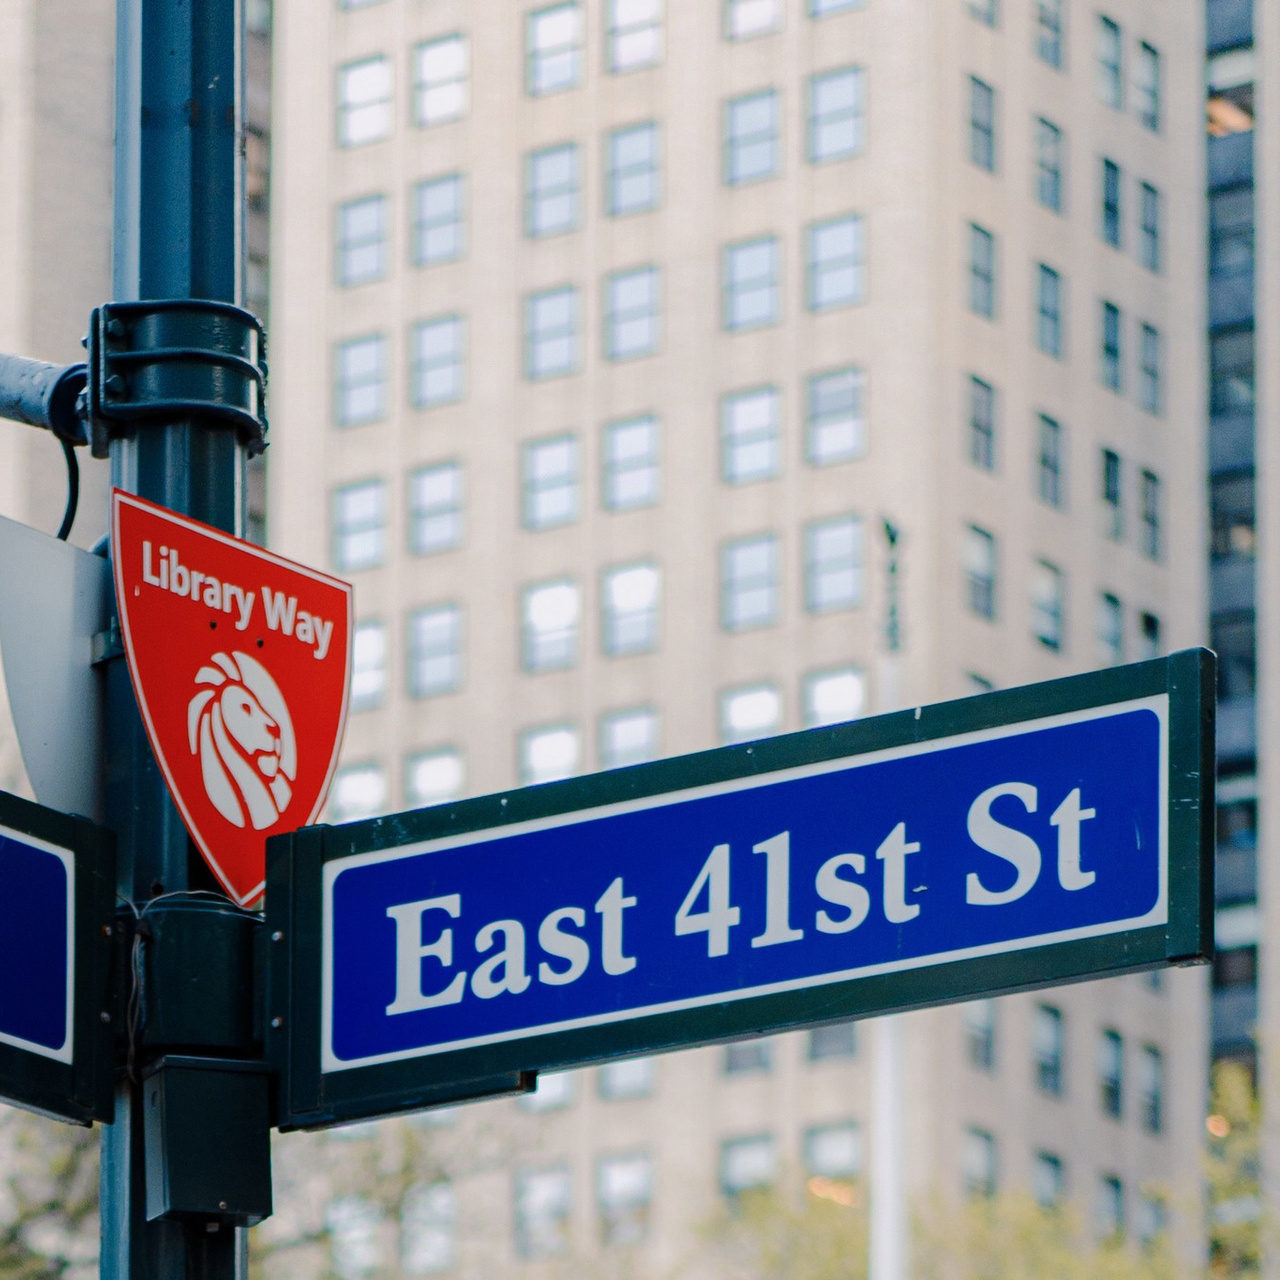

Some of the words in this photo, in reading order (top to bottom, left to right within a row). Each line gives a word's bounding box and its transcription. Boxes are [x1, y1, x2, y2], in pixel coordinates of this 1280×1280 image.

[142, 540, 256, 631] Library
[261, 586, 334, 660] Way
[386, 877, 637, 1016] East
[675, 821, 921, 958] 41st
[966, 781, 1096, 906] St
